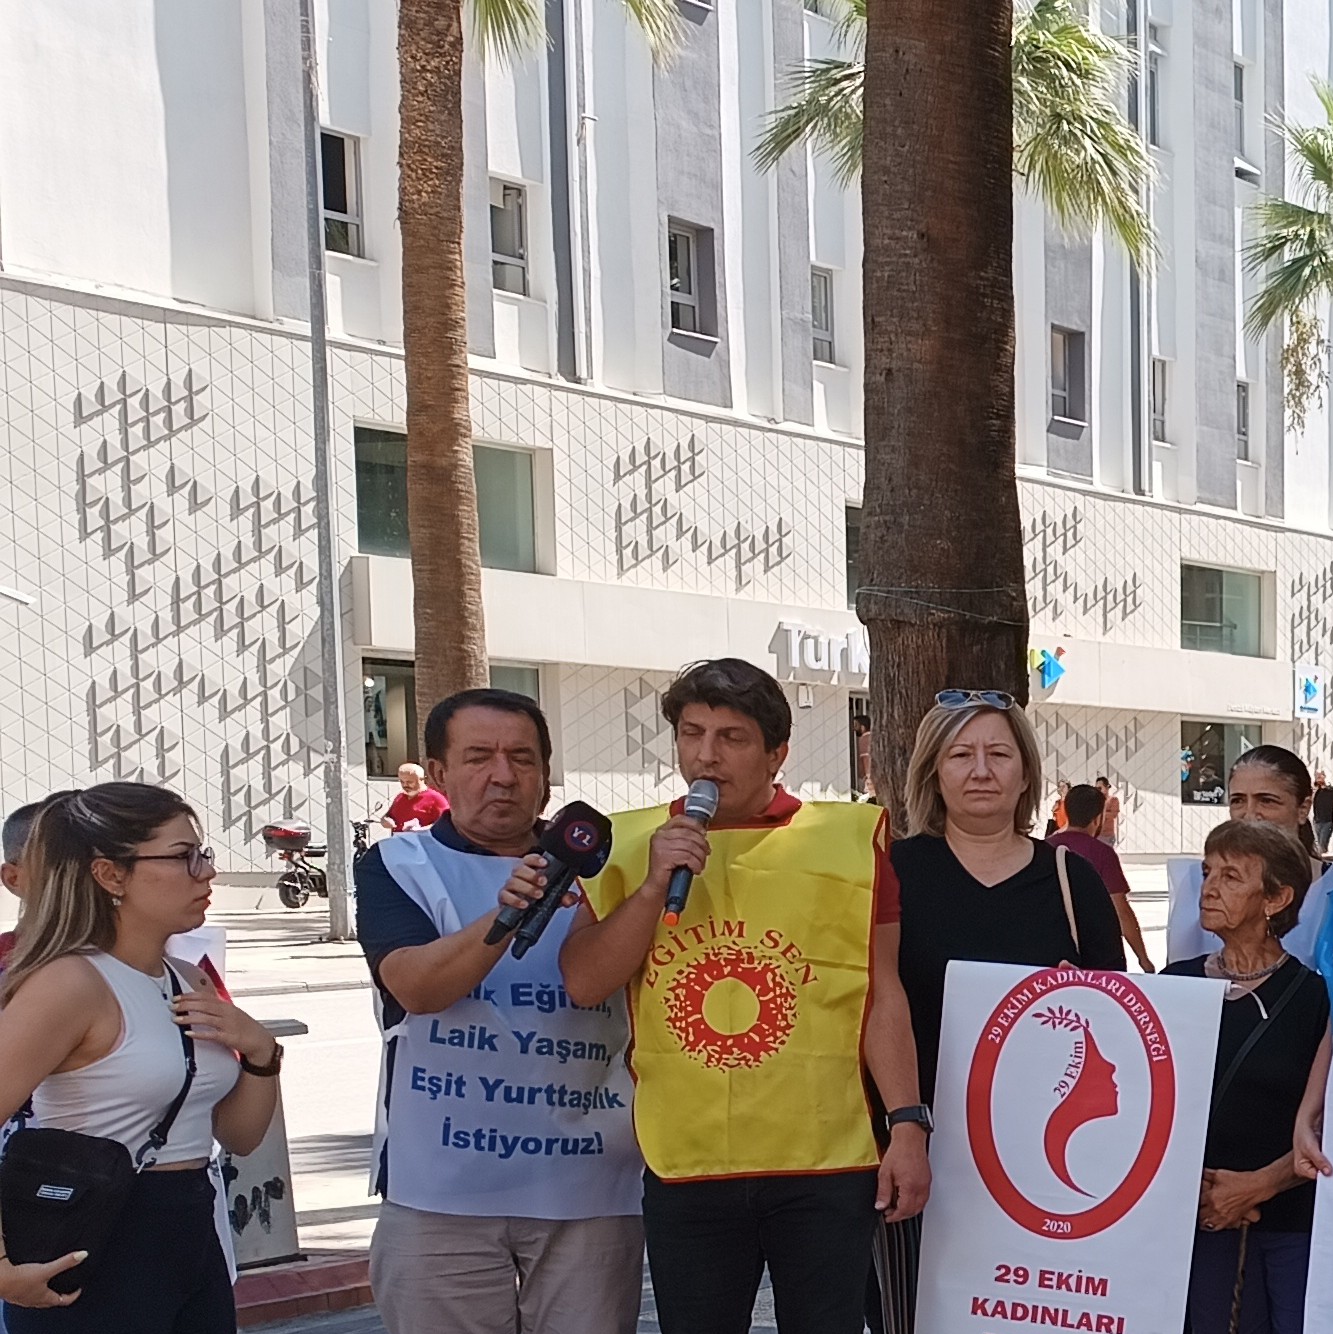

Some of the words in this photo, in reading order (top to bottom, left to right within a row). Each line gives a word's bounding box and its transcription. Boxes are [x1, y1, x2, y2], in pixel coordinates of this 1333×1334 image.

[760, 929, 819, 986] SEN
[988, 1025, 1004, 1044] 29
[998, 989, 1033, 1027] EKİM
[1032, 969, 1124, 996] KADINLARI
[1123, 992, 1168, 1062] DERNEĞİ
[429, 1019, 499, 1052] Laik
[512, 1030, 612, 1066] Yaşam,
[411, 1066, 466, 1101] Eşit
[478, 1076, 626, 1115] Yurttaşlık
[1053, 1081, 1071, 1099] 29
[1064, 1040, 1085, 1080] Ekim
[441, 1116, 604, 1160] İstiyoruz!
[1042, 1219, 1072, 1233] 2020
[994, 1264, 1030, 1285] 29
[1038, 1269, 1109, 1297] EKİM
